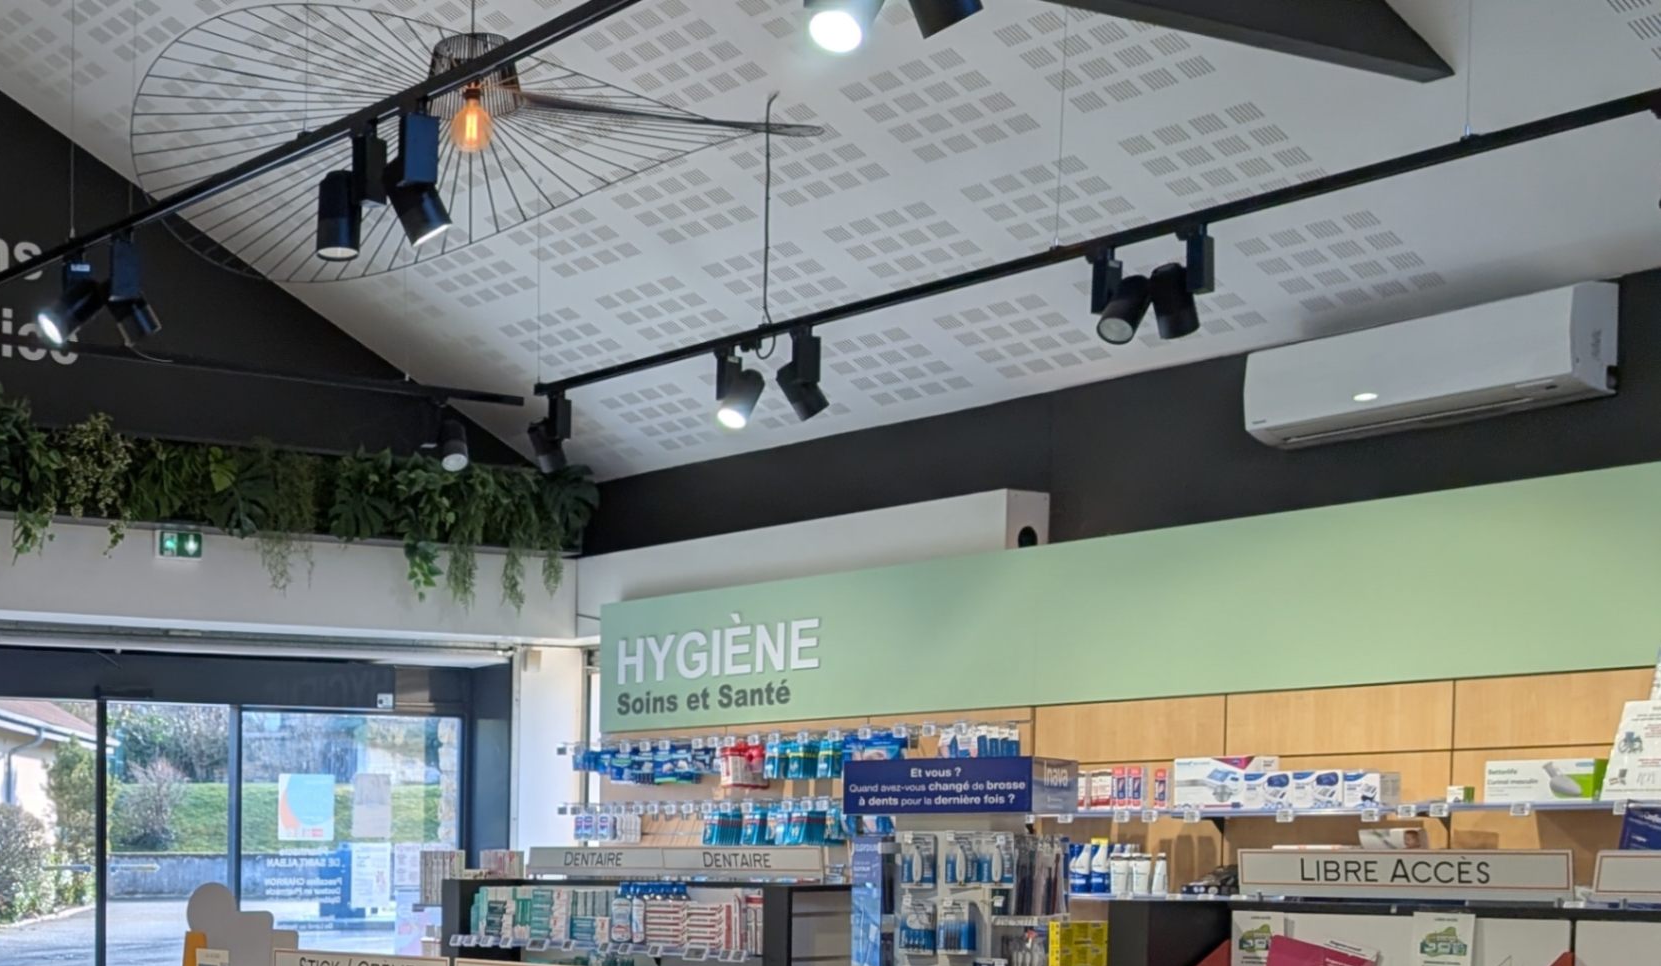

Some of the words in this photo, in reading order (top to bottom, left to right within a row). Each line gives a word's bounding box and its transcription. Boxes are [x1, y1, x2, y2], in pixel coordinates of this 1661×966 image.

[616, 613, 821, 686] HYGIÈNE
[616, 688, 679, 716] Soins
[686, 686, 710, 711] et
[717, 679, 792, 710] Santé
[910, 767, 922, 778] Et
[925, 768, 953, 778] vous
[955, 766, 962, 777] ?
[849, 784, 879, 793] Quand
[880, 783, 926, 793] avez-vous
[928, 780, 970, 794] changé
[972, 781, 985, 791] de
[986, 779, 1026, 790] brosse
[858, 795, 865, 806] à
[868, 796, 898, 806] dents
[900, 797, 922, 808] pour
[923, 796, 932, 806] la
[934, 794, 982, 806] dernière
[983, 794, 1006, 804] fois
[1008, 794, 1016, 804] ?
[563, 852, 623, 867] DENTAIRE
[702, 852, 772, 869] DENTAIRE
[1299, 858, 1379, 883] LIBRE
[1390, 855, 1491, 885] ACCÈS
